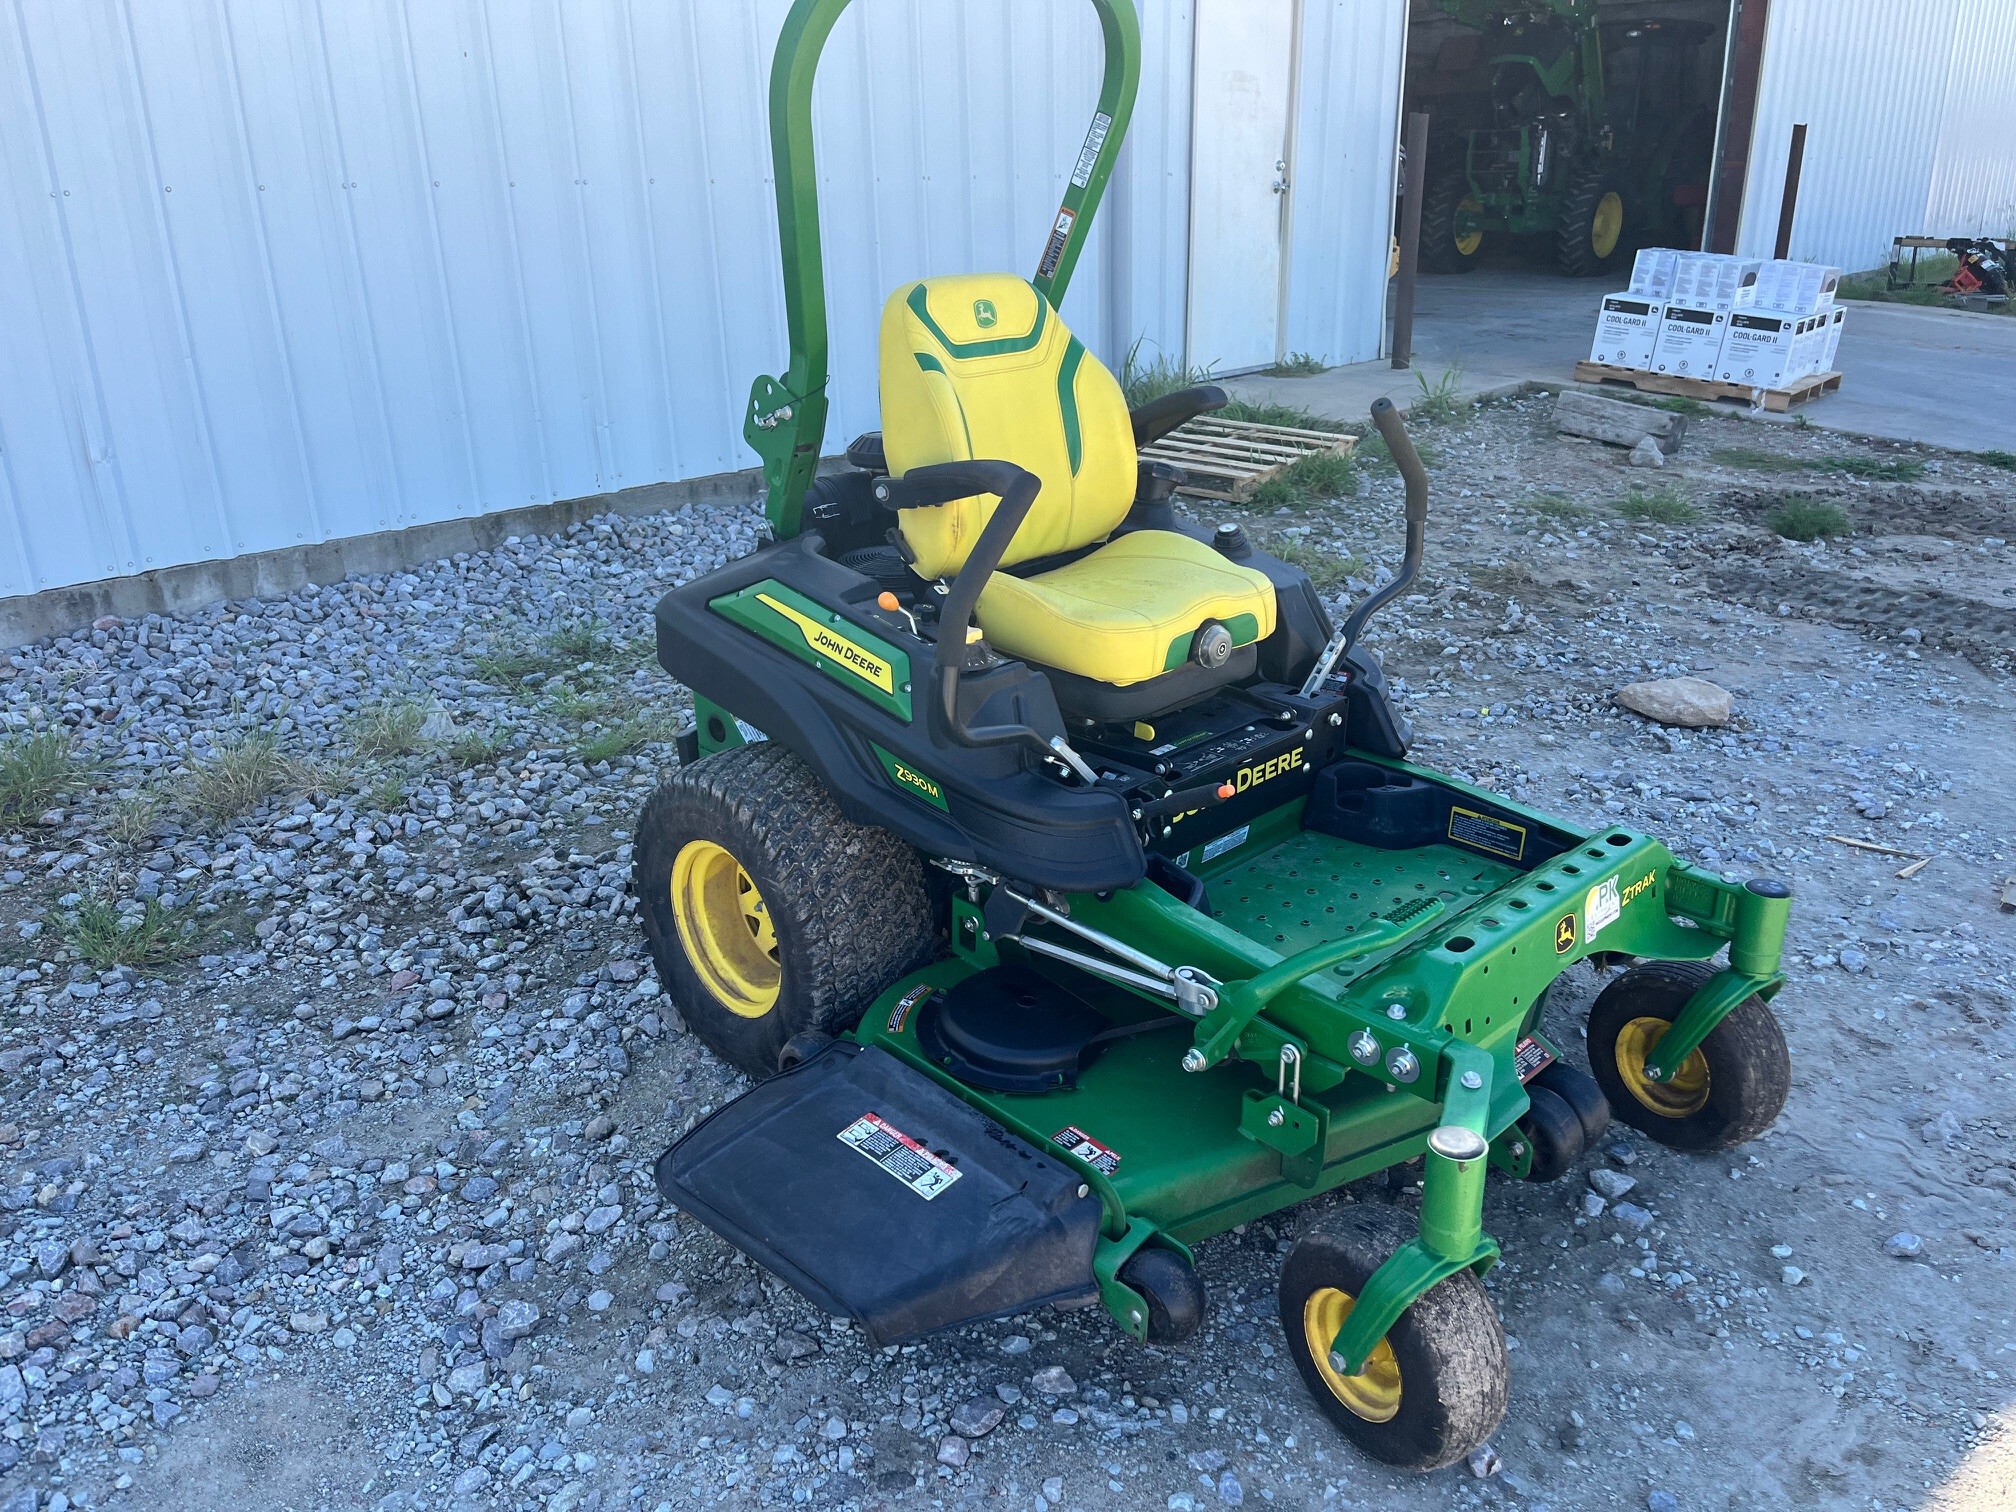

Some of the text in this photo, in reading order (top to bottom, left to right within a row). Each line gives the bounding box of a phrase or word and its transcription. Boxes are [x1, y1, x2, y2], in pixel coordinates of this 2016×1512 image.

[813, 631, 882, 677] JOHN DEERE
[895, 763, 939, 798] Z930M
[1236, 747, 1304, 794] DEERE
[1599, 874, 1618, 907] PK
[1621, 868, 1656, 907] ZTRAK
